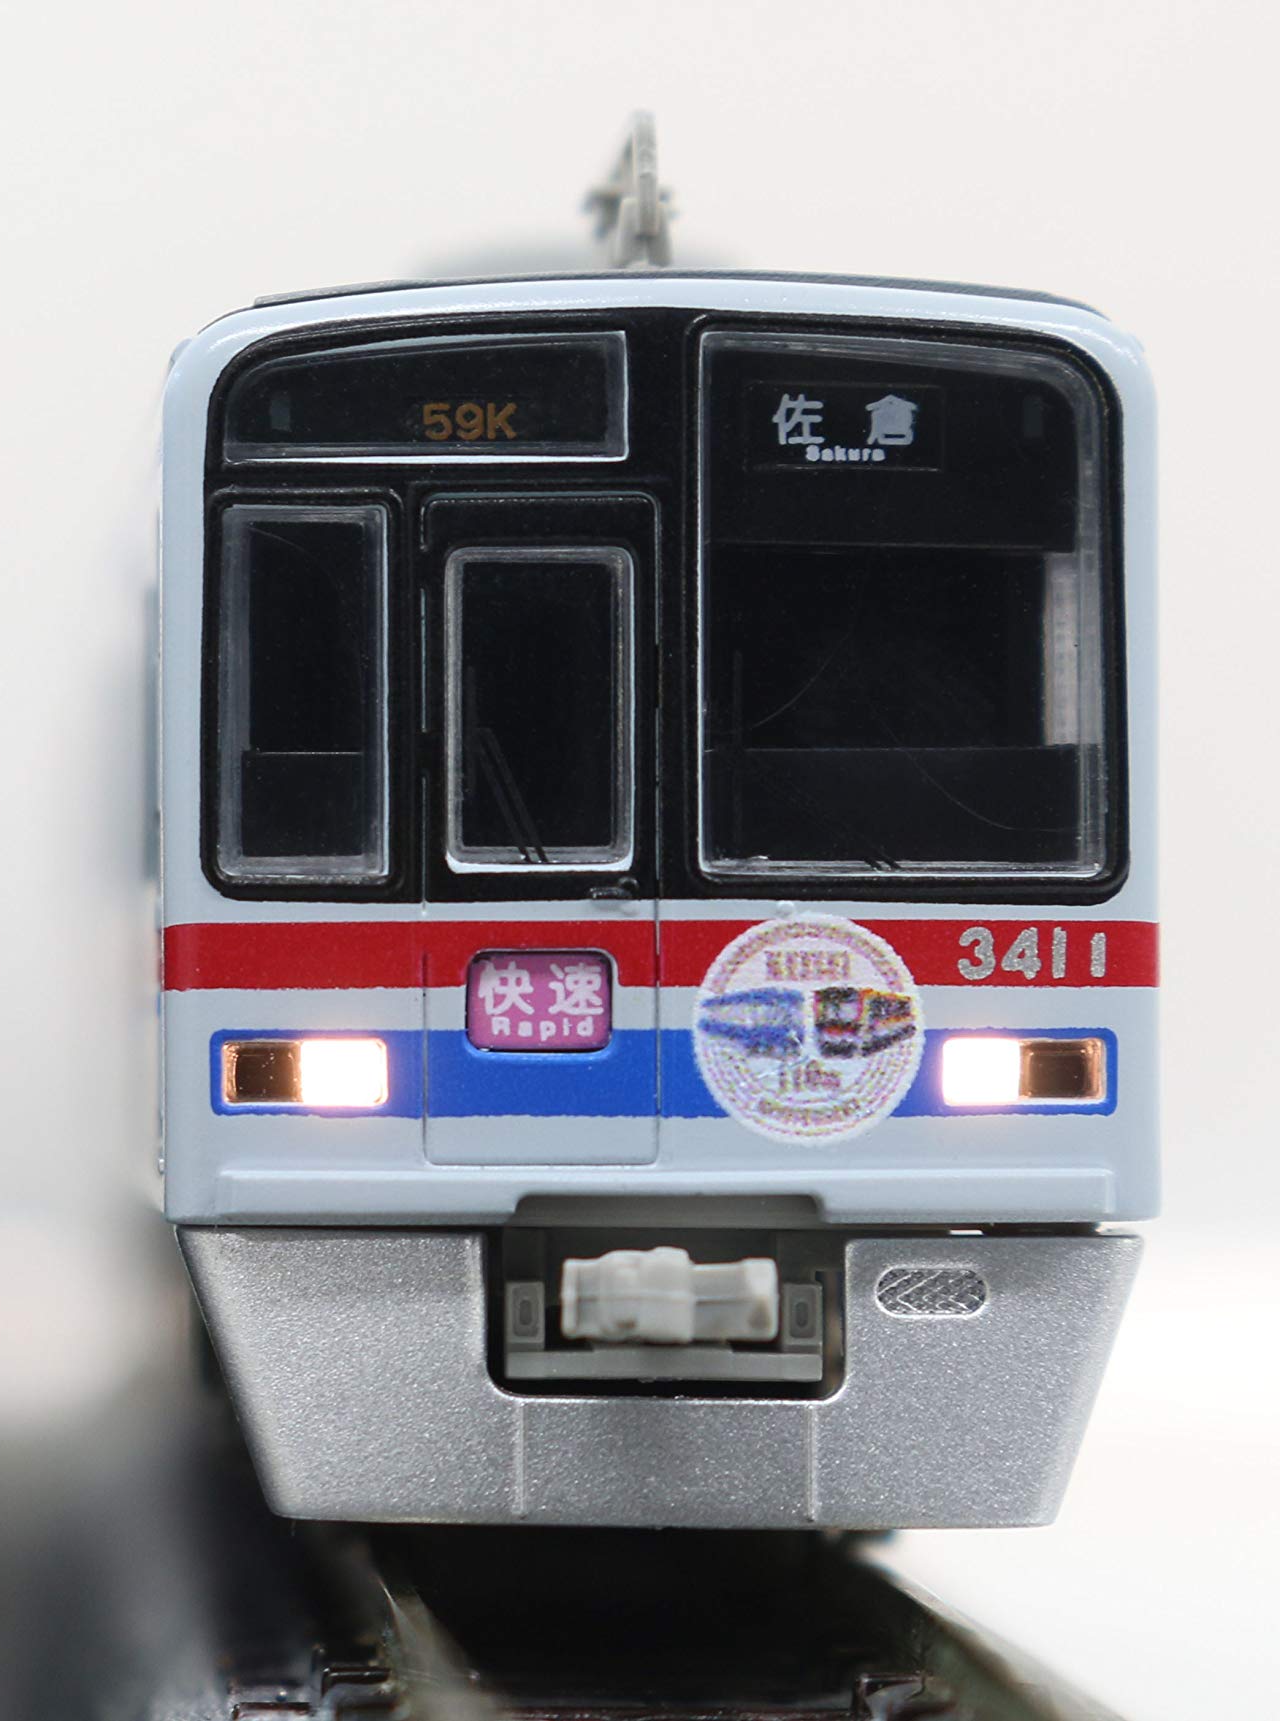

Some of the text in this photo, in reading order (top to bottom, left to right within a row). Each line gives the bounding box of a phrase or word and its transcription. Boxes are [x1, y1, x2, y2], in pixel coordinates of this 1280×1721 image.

[422, 402, 517, 441] 59K
[805, 445, 887, 463] Sakura
[956, 926, 1108, 981] 3411
[478, 963, 606, 1018] 快速
[490, 1015, 595, 1040] Rapid
